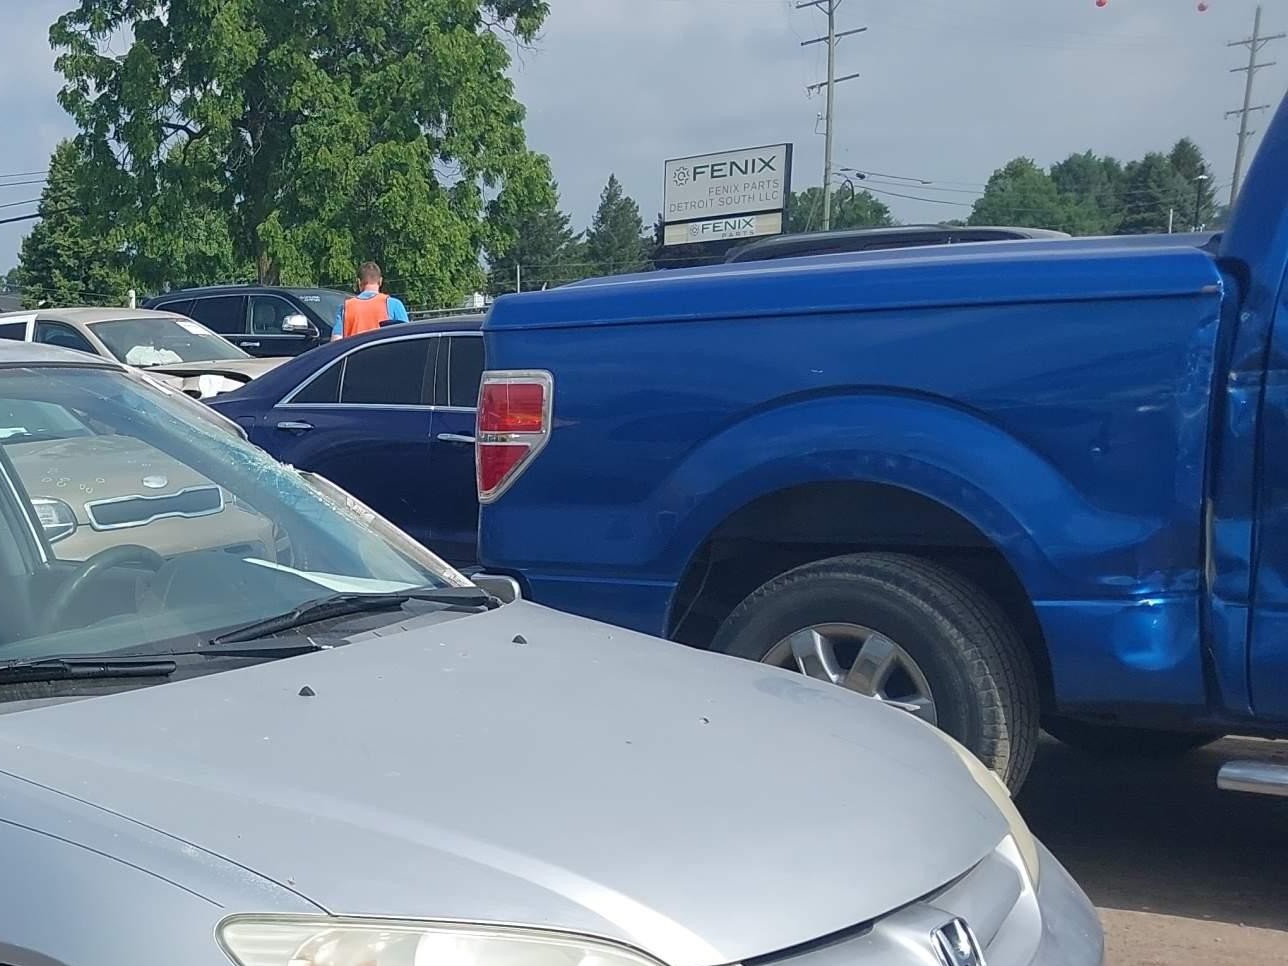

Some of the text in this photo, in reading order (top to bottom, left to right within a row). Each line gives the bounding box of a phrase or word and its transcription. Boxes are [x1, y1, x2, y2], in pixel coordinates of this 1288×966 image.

[692, 155, 777, 182] FENIX
[708, 178, 780, 196] FENIX PARTS
[669, 190, 779, 213] DETROIT SOUTH LLC
[701, 217, 754, 234] FENIX
[721, 230, 754, 238] PARTS
